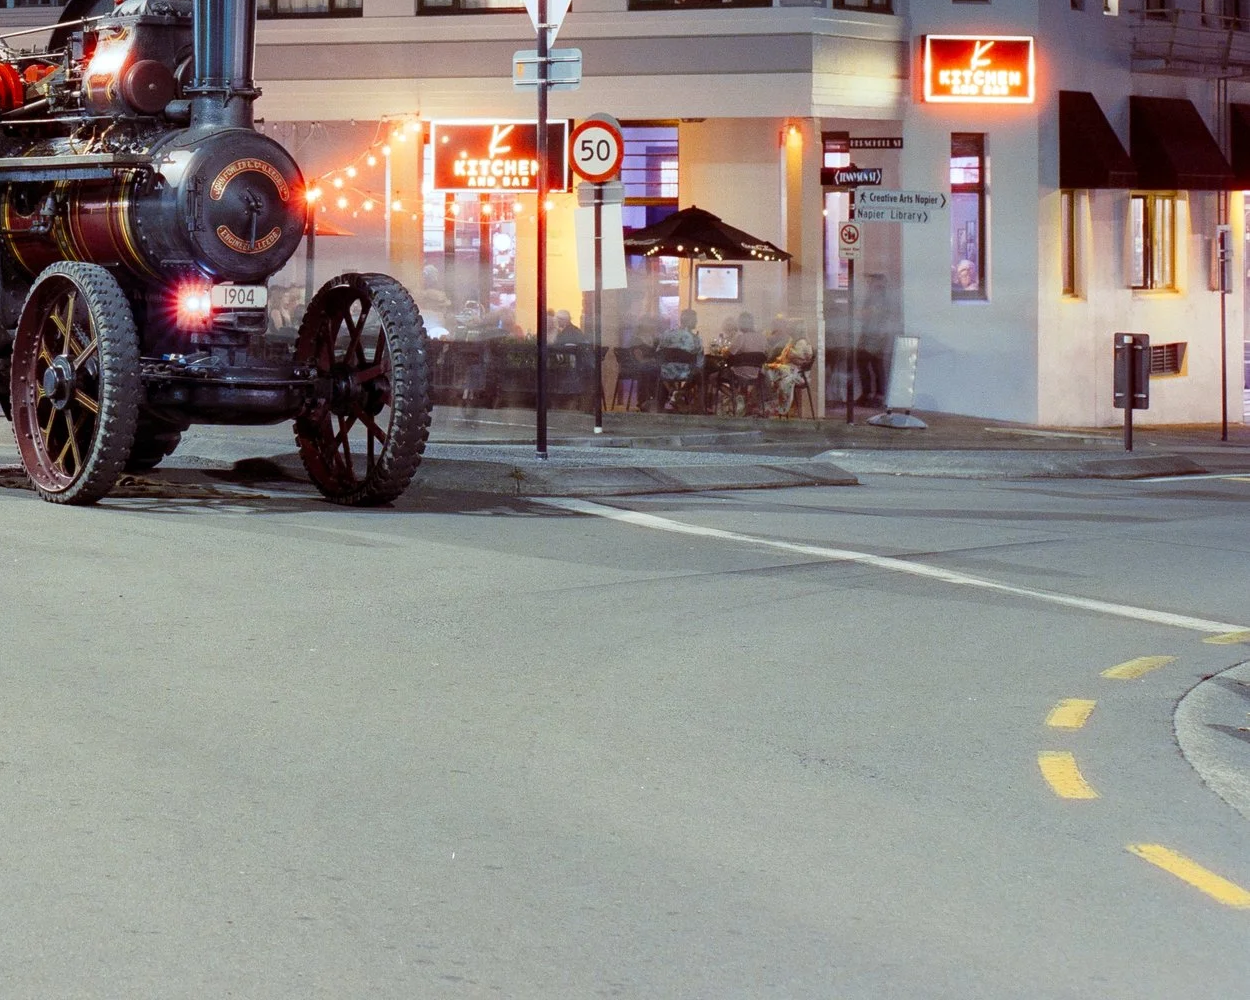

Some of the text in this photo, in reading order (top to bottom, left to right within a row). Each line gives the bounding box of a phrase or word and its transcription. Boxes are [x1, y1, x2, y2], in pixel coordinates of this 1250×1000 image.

[938, 69, 1021, 87] KITCHEN
[581, 139, 610, 161] 50
[453, 159, 539, 177] KITCHEN
[213, 176, 227, 195] JOHN
[223, 161, 247, 179] FOWLER
[467, 176, 530, 187] AND BAR
[869, 192, 938, 206] Creative Arts Napier
[857, 208, 922, 222] Napier Library
[220, 229, 278, 251] ENGINEE LEEDS
[224, 287, 254, 304] 1904
